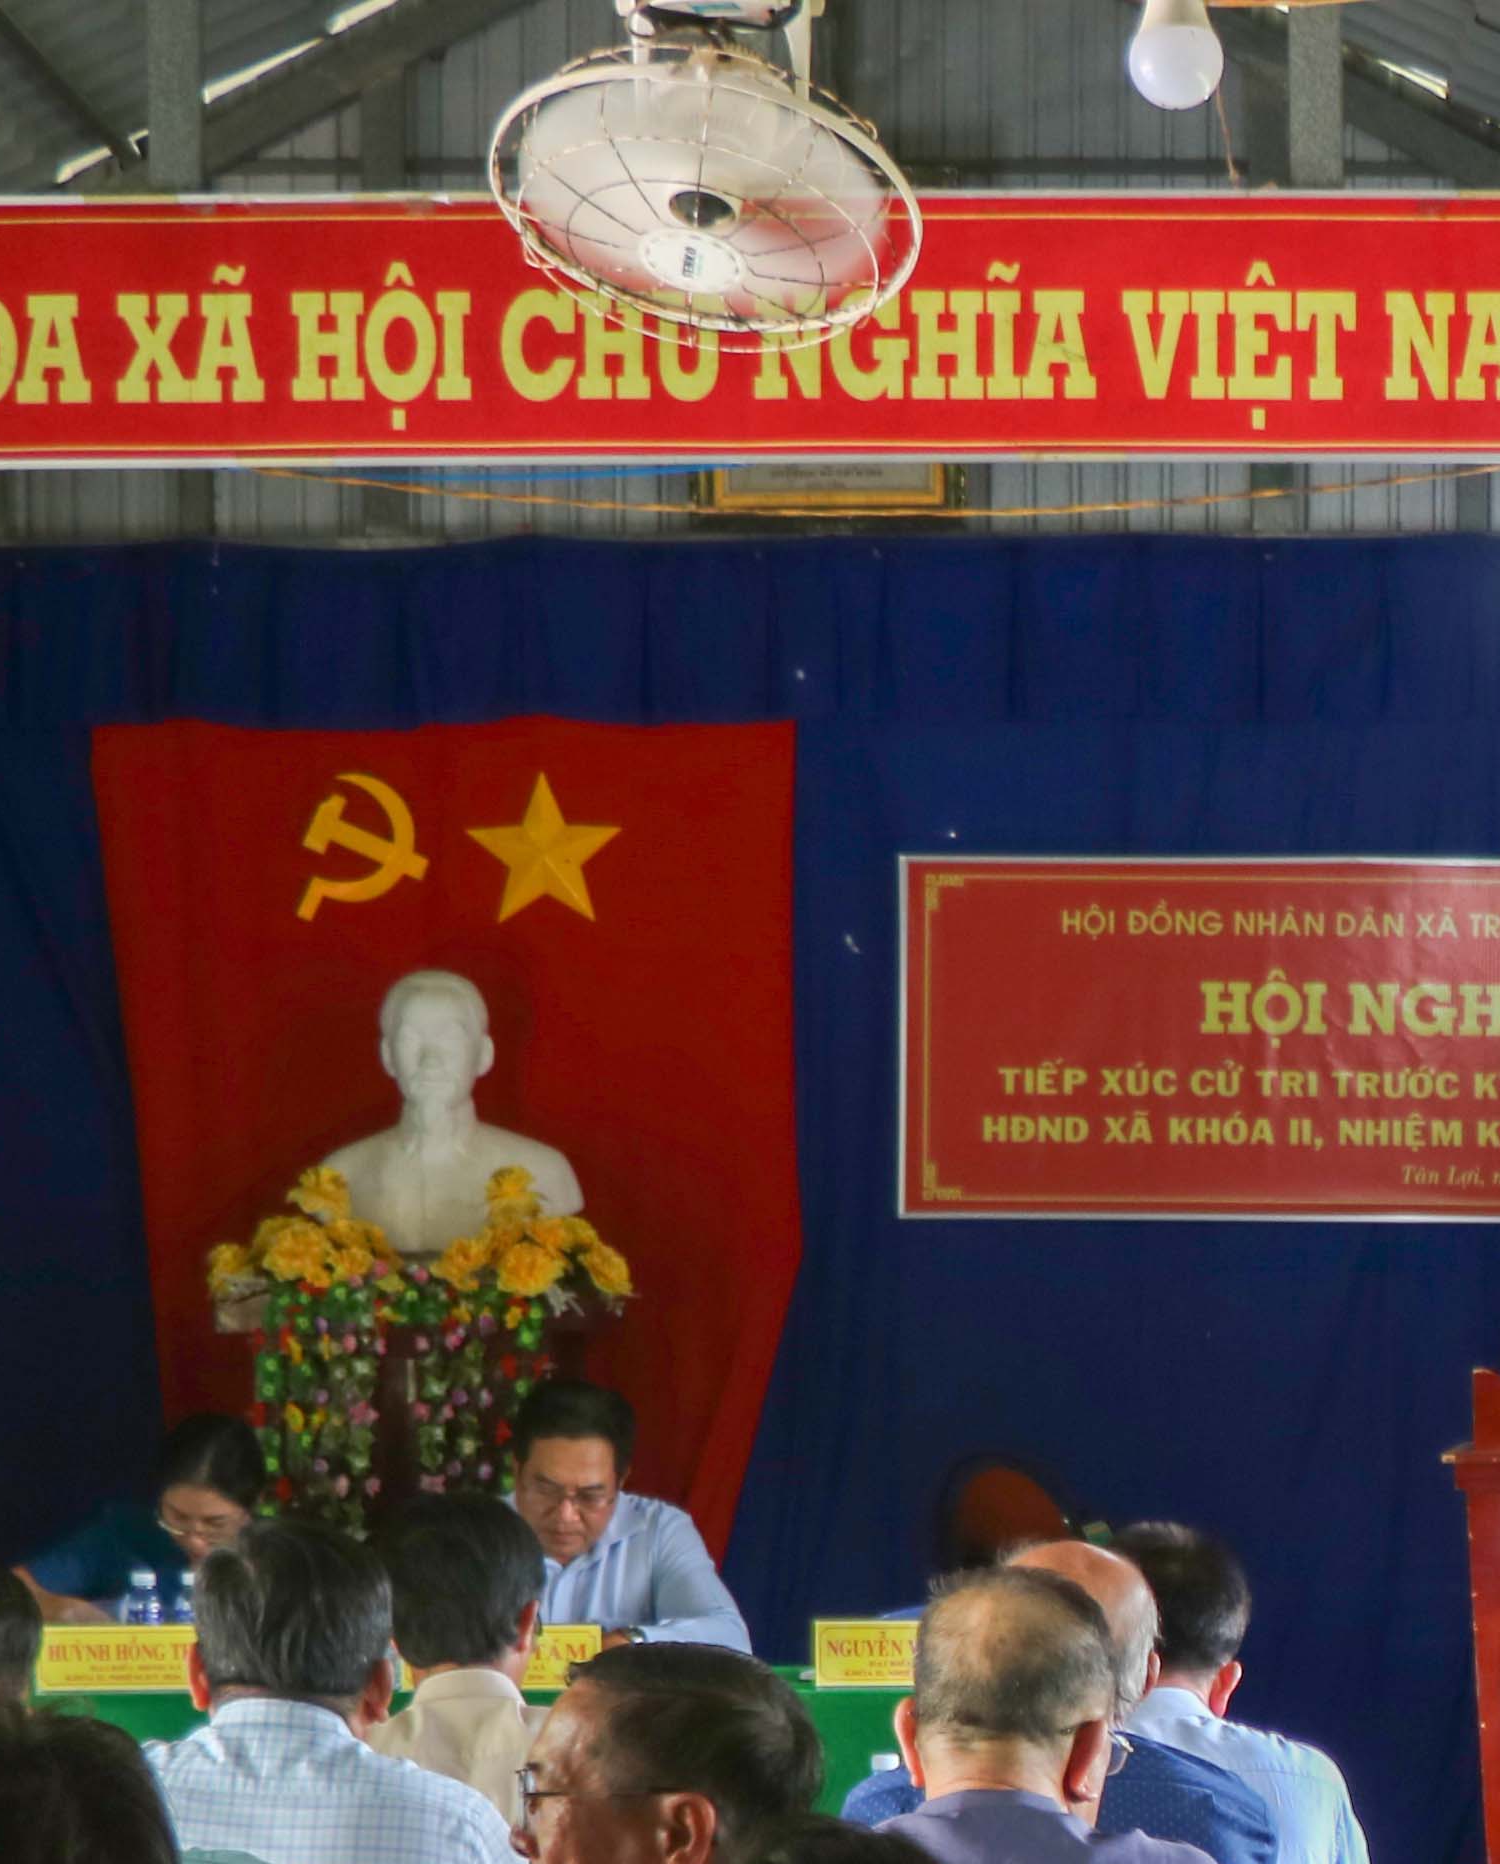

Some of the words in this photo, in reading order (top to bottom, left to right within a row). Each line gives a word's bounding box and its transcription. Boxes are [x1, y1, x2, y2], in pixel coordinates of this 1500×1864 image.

[116, 264, 266, 403] XÃ
[292, 262, 472, 429] HỘI
[755, 261, 1095, 401] NGHĨA
[1121, 262, 1356, 430] VIỆT
[1061, 908, 1116, 938] HỘI
[1127, 900, 1223, 936] ĐỒNG
[1234, 906, 1325, 938] NHÂN
[1336, 907, 1404, 939] DÂN
[1415, 907, 1458, 939] XÃ
[1199, 970, 1328, 1047] HỘI
[999, 1057, 1087, 1096] TIẾP
[1101, 1057, 1178, 1097] XÚC
[1190, 1060, 1244, 1098] CỬ
[1257, 1070, 1318, 1098] TRI
[1335, 1061, 1460, 1100] TRƯỚC
[983, 1116, 1089, 1145] HĐND
[1105, 1108, 1154, 1145] XÃ
[1169, 1109, 1274, 1147] KHÓA
[1287, 1119, 1323, 1151] II,
[1338, 1113, 1463, 1157] NHIỆM
